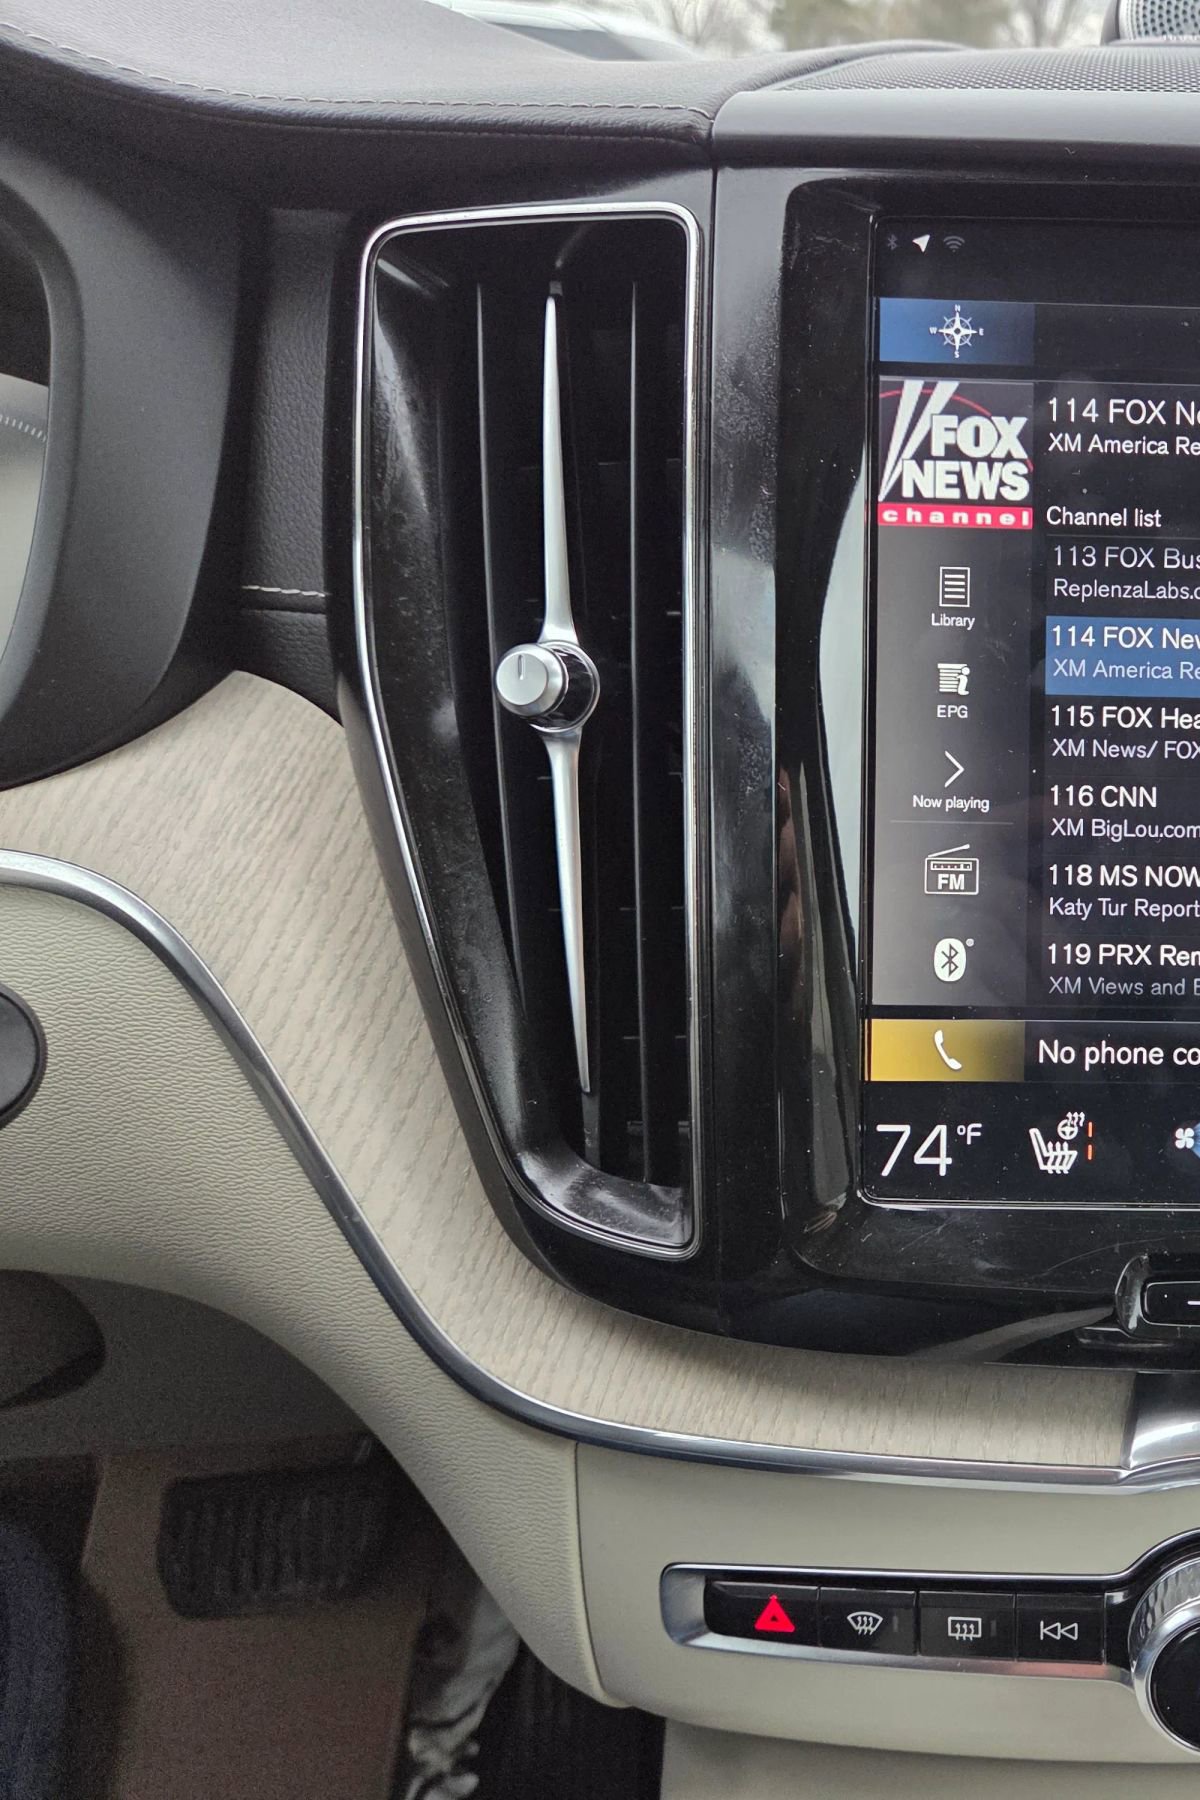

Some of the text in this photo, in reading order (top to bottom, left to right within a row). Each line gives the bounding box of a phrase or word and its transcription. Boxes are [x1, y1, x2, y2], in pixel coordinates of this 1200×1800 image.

[954, 304, 961, 312] N
[929, 326, 938, 334] W
[978, 328, 985, 336] E
[953, 351, 960, 359] S
[1048, 396, 1099, 423] 114
[1108, 398, 1167, 425] FOX
[930, 414, 1028, 460] FOX
[1047, 432, 1082, 453] XM
[1087, 433, 1170, 455] America
[901, 459, 1031, 501] NEWS
[882, 507, 1031, 527] channel
[1046, 505, 1162, 528] Channel list
[1054, 545, 1097, 567] 113
[1104, 546, 1156, 569] FOX
[931, 612, 976, 631] Library
[1052, 624, 1096, 647] 114
[1103, 626, 1155, 649] FOX
[1052, 658, 1086, 678] XM
[1092, 659, 1174, 680] America
[936, 704, 969, 719] EPG
[1051, 704, 1095, 728] 115
[1102, 705, 1153, 729] FOX
[1051, 738, 1085, 757] XM
[1092, 738, 1159, 759] News/
[912, 794, 990, 813] Now playing
[1050, 784, 1157, 808] 116 CNN
[1050, 817, 1084, 837] XM
[937, 873, 965, 891] FM
[1049, 863, 1093, 887] 118
[1099, 864, 1138, 888] MS
[1049, 896, 1093, 921] Katy
[1097, 897, 1128, 917] Tur
[1048, 943, 1091, 965] 119
[1098, 943, 1152, 966] PRX
[1048, 975, 1082, 994] XM
[1087, 976, 1144, 995] Views
[1150, 977, 1186, 996] and
[1038, 1039, 1076, 1065] No
[1084, 1039, 1165, 1069] phone
